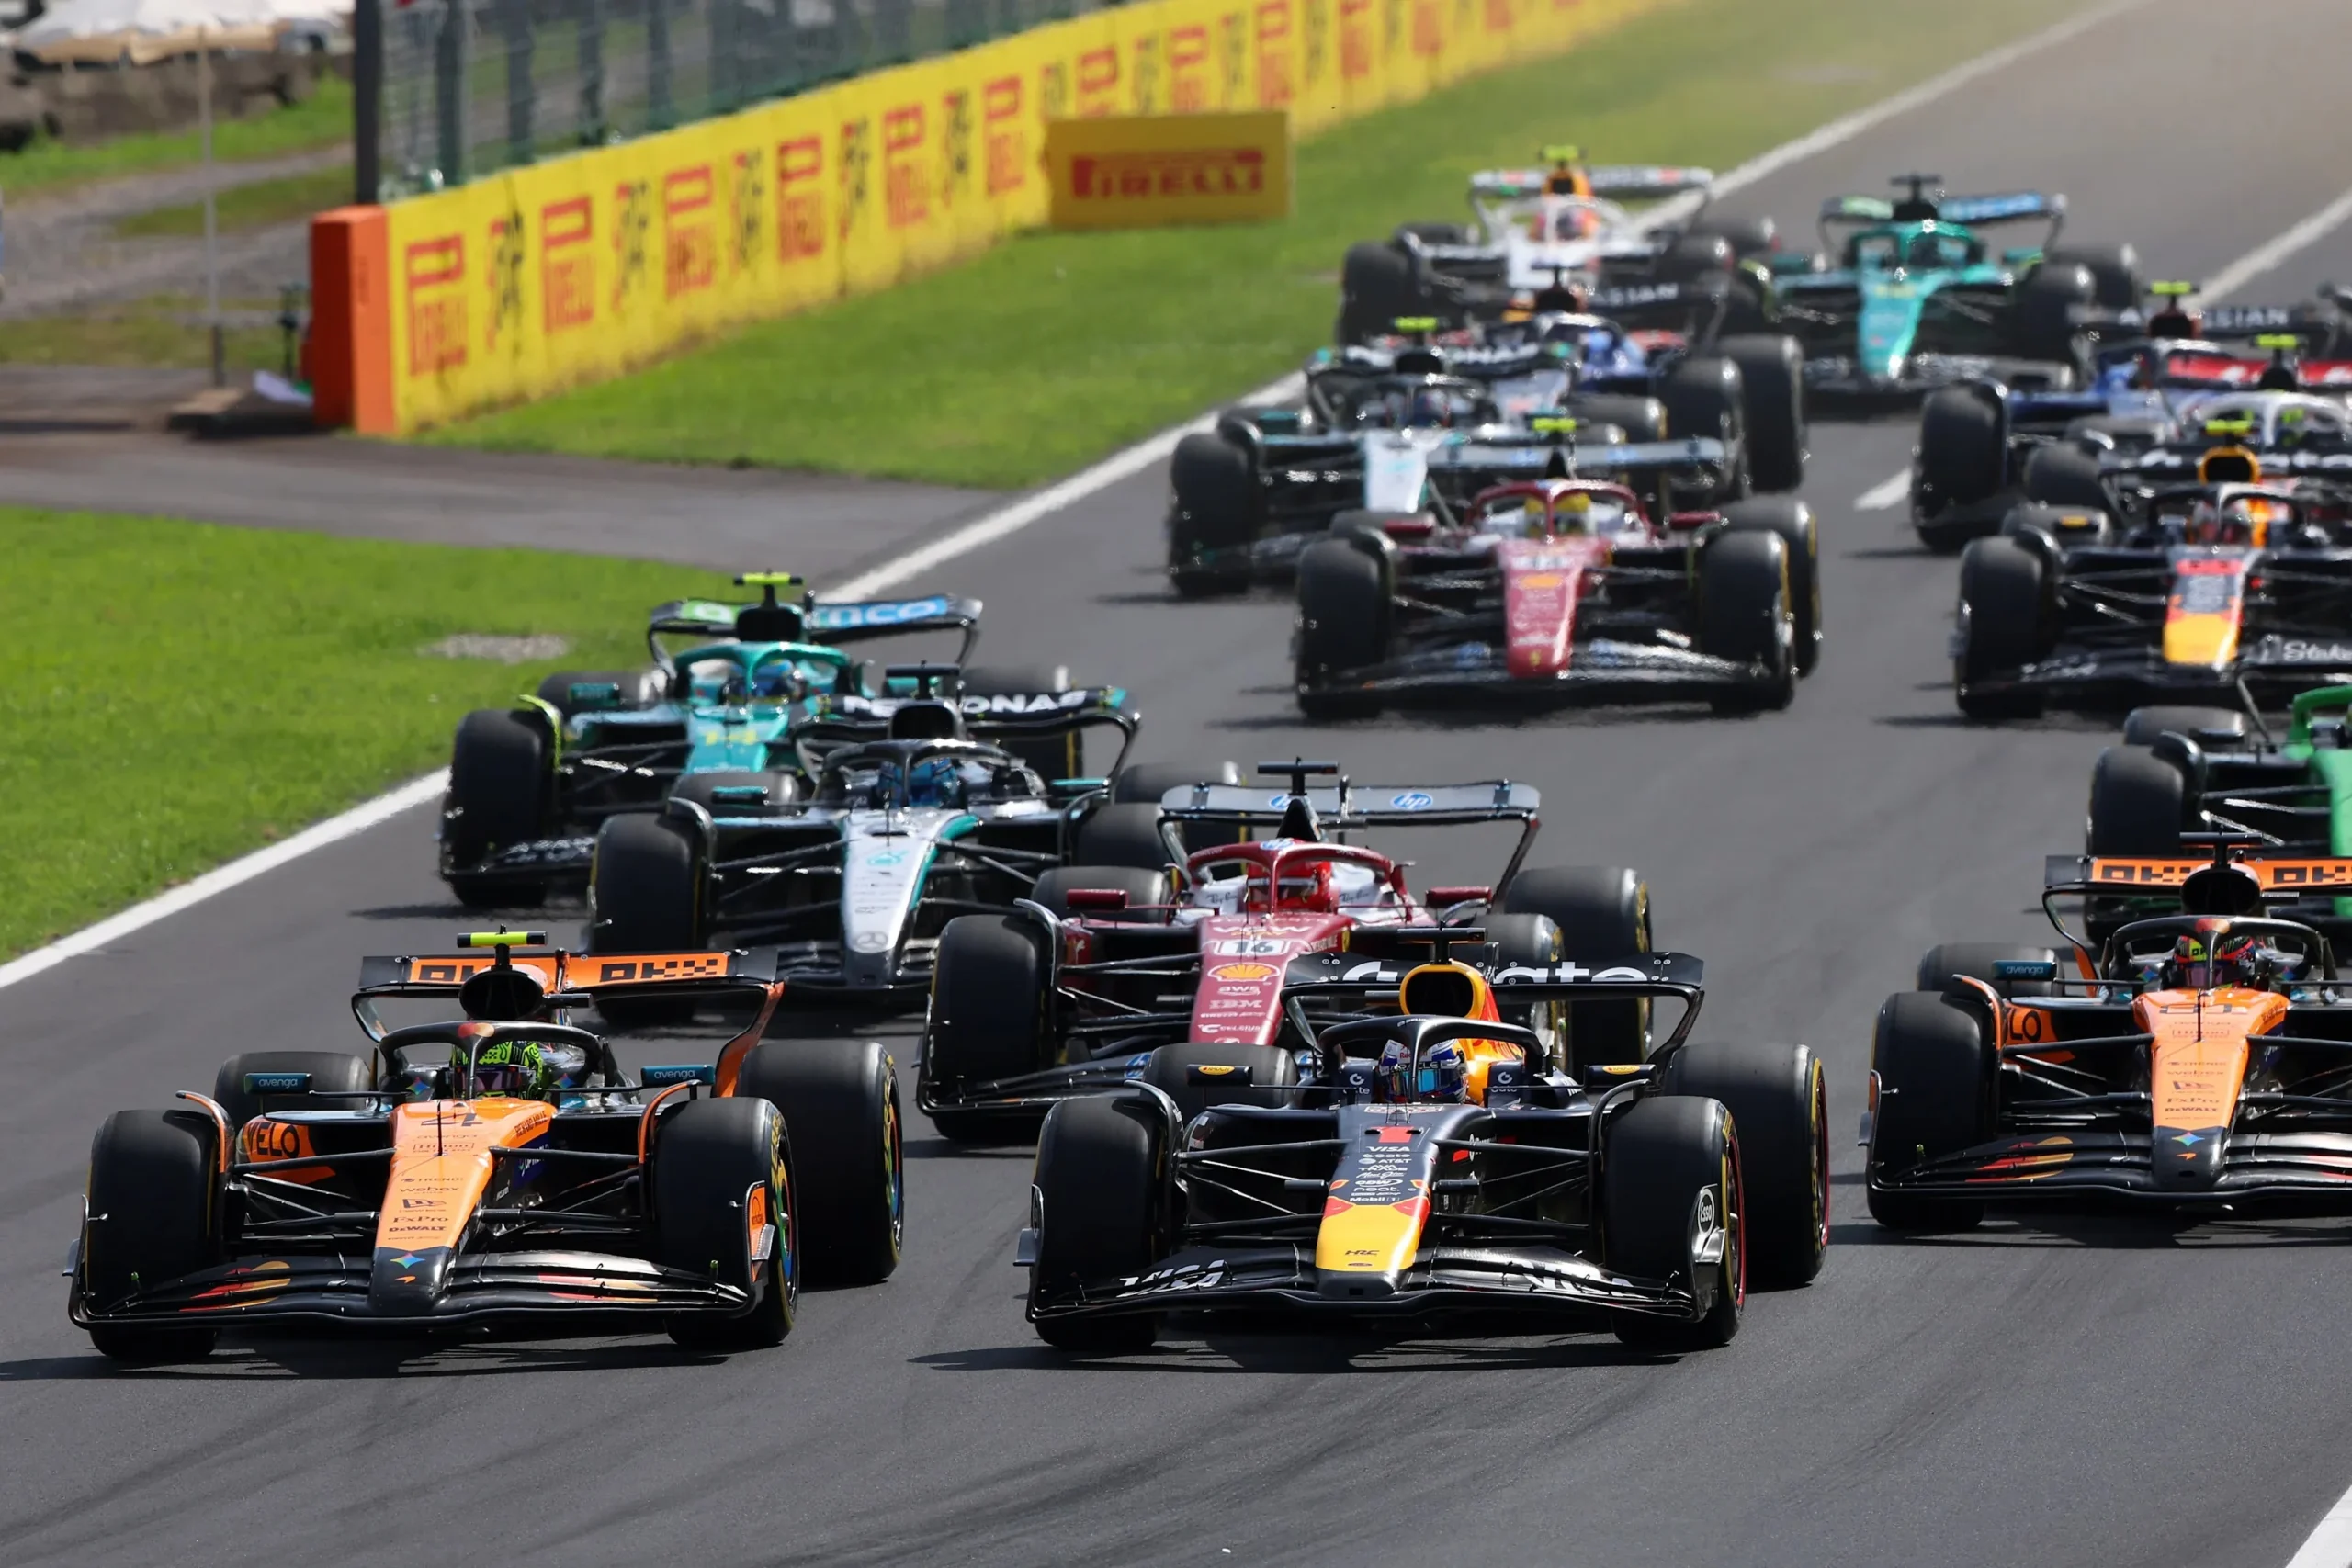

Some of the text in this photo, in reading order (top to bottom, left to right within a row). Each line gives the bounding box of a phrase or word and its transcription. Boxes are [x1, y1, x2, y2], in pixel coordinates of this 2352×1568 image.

[1234, 940, 1275, 954] 16
[2006, 965, 2044, 976] avenga
[1209, 999, 1263, 1009] IBM
[654, 1068, 695, 1080] avenga
[258, 1077, 299, 1089] avenga
[1700, 1201, 1713, 1223] Esso
